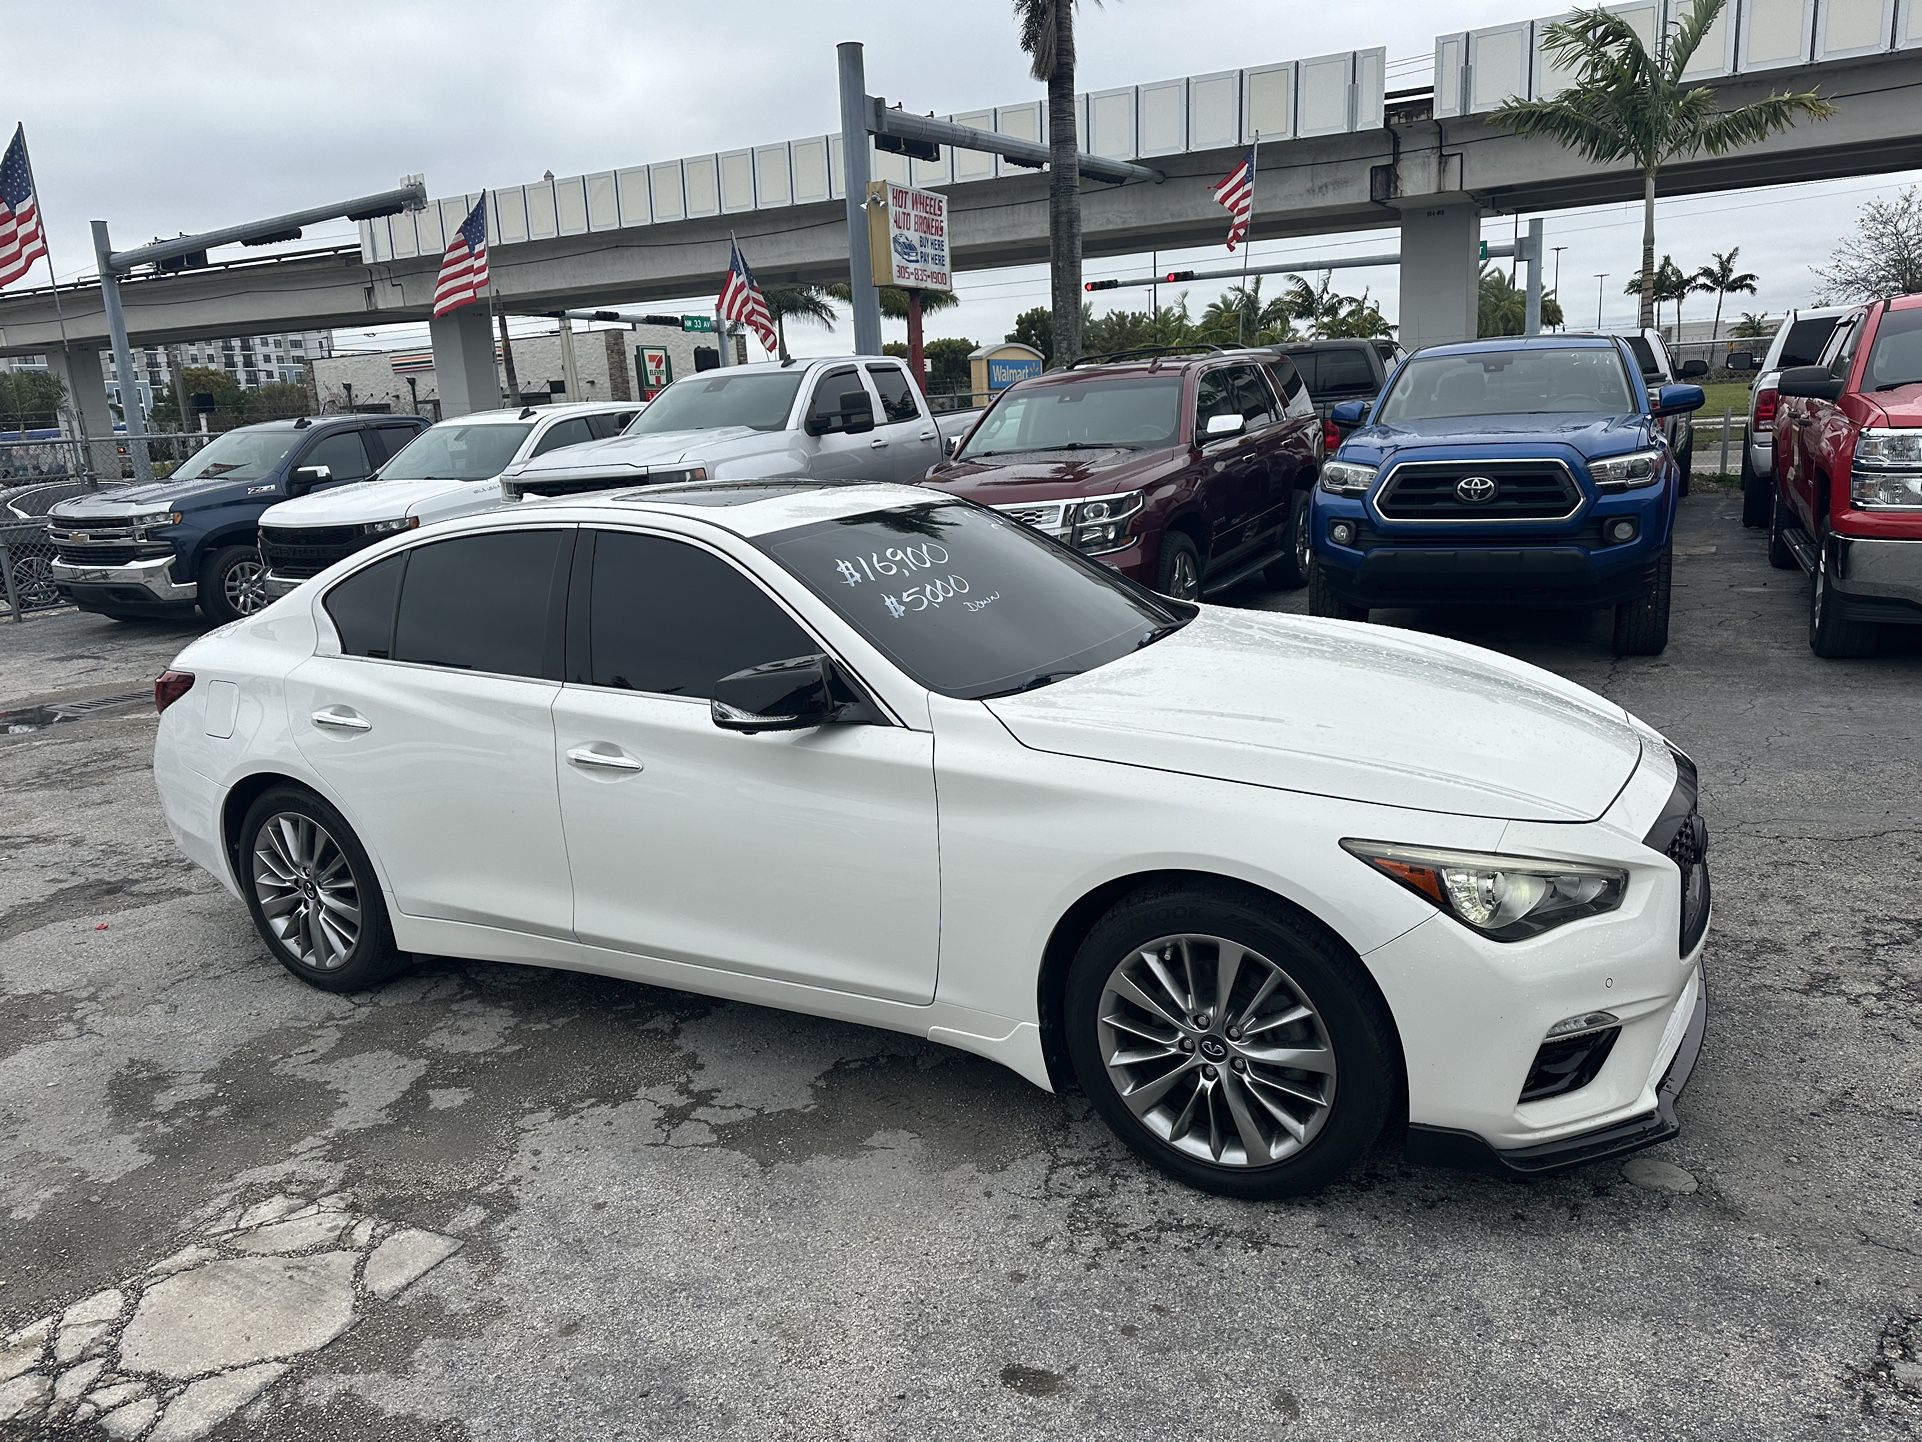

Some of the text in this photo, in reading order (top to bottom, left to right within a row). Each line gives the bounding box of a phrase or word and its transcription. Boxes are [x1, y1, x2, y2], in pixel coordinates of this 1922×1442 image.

[892, 188, 943, 217] HOT WHEELS
[893, 210, 944, 237] AUTO BROKERS
[919, 235, 945, 252] BUY HERE
[920, 251, 946, 267] PAY HERE
[896, 265, 947, 286] 305-835-1900
[693, 319, 702, 328] 33
[992, 365, 1029, 382] Walmart
[834, 542, 949, 587] $16,900
[880, 574, 970, 619] $5,000
